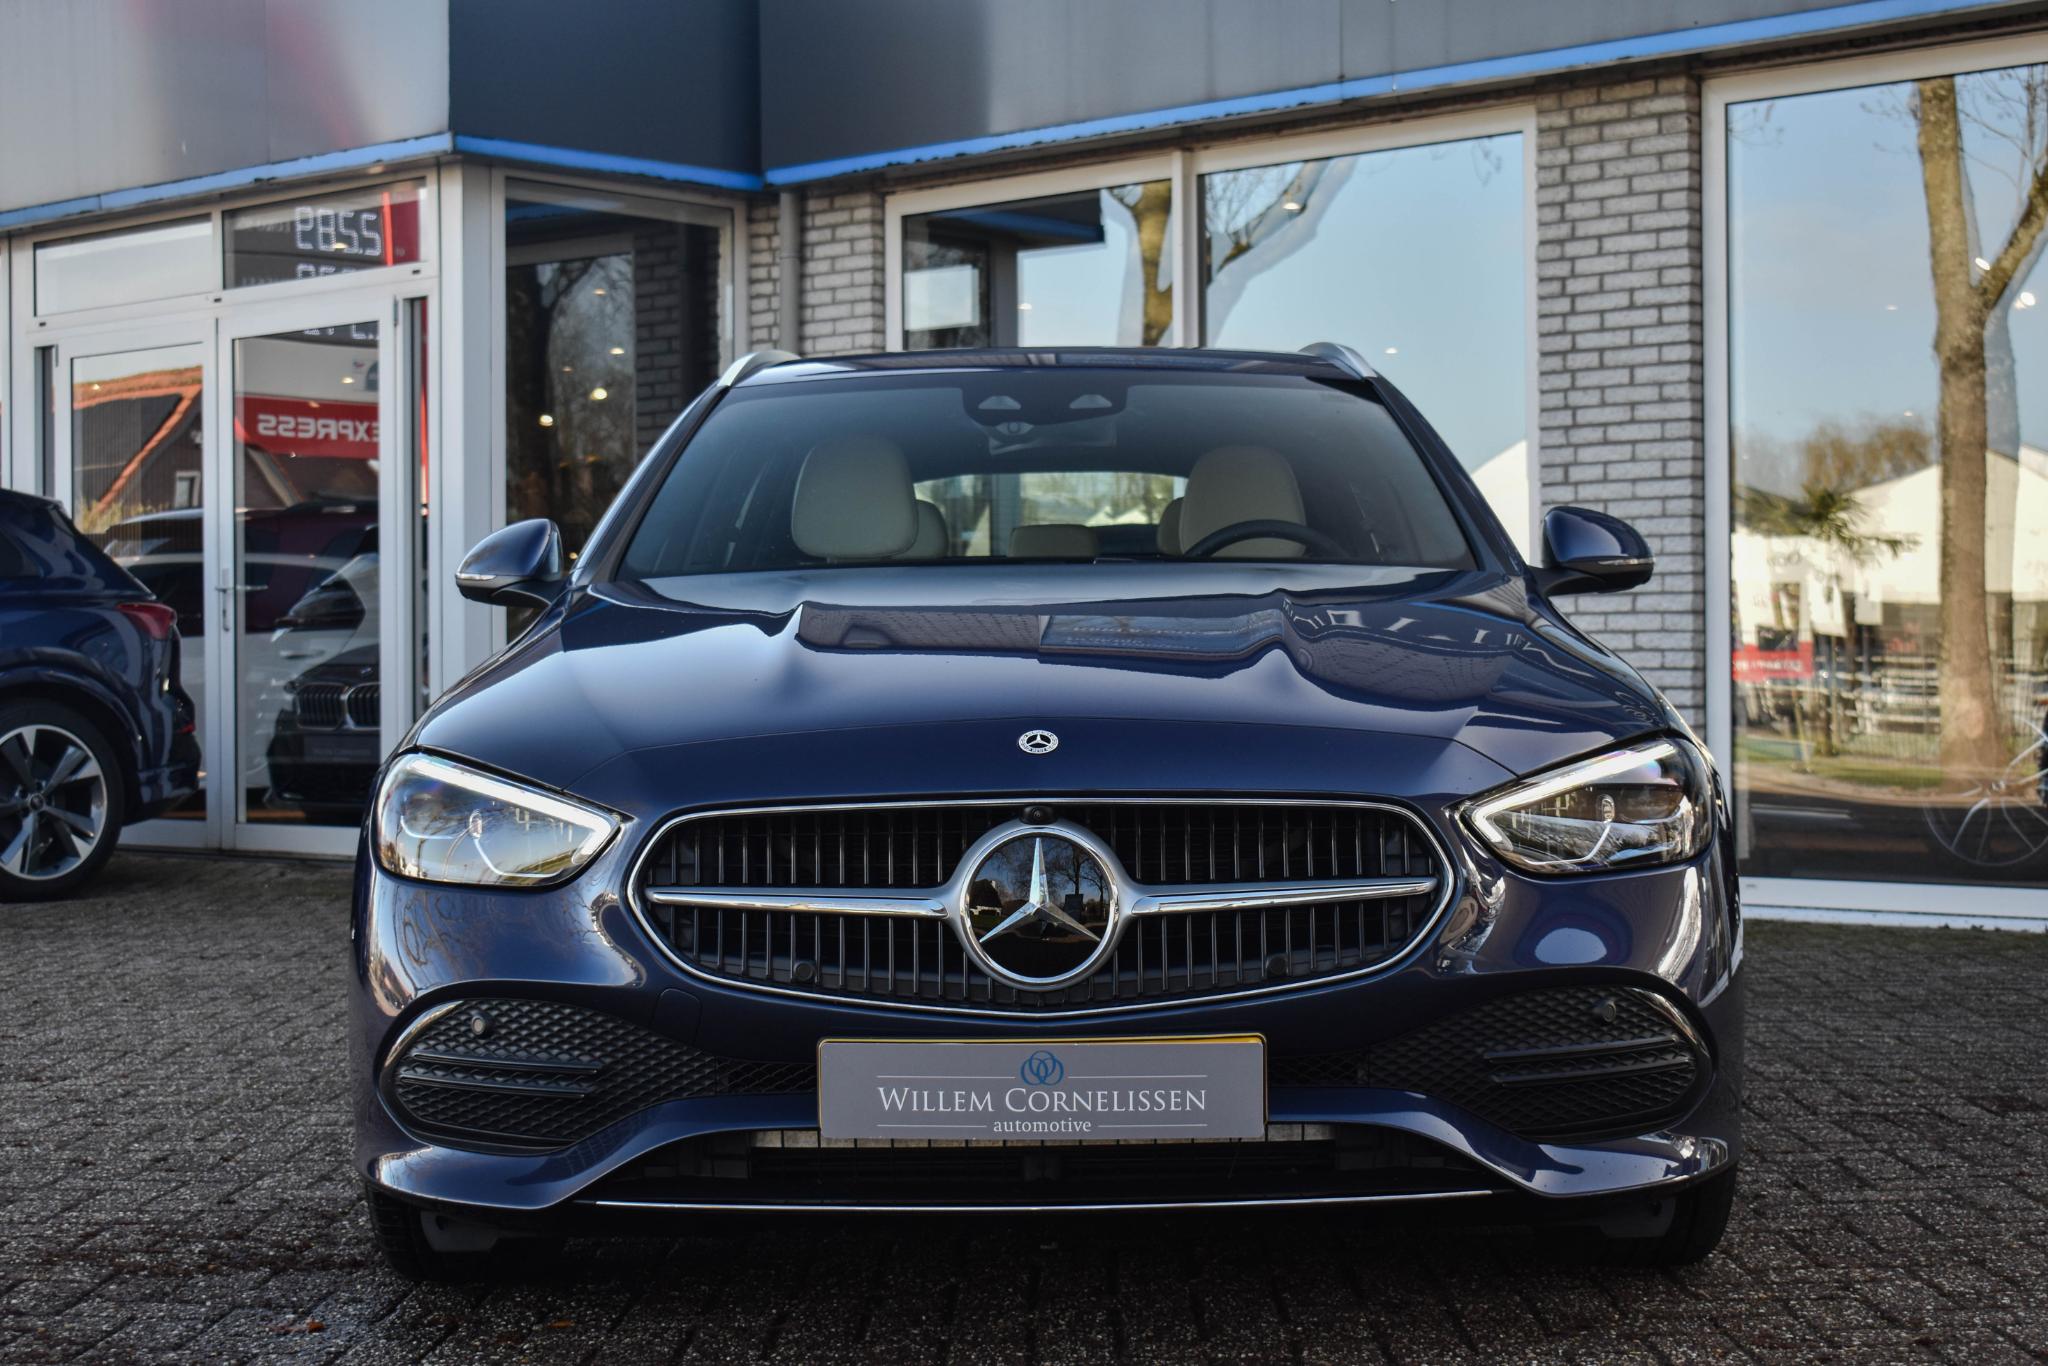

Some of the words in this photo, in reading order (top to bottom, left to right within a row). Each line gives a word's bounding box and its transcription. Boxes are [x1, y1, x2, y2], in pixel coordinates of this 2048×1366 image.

[877, 1087, 995, 1112] WILLEM
[1005, 1088, 1207, 1112] CORNELISSEN
[993, 1118, 1092, 1132] automotive
